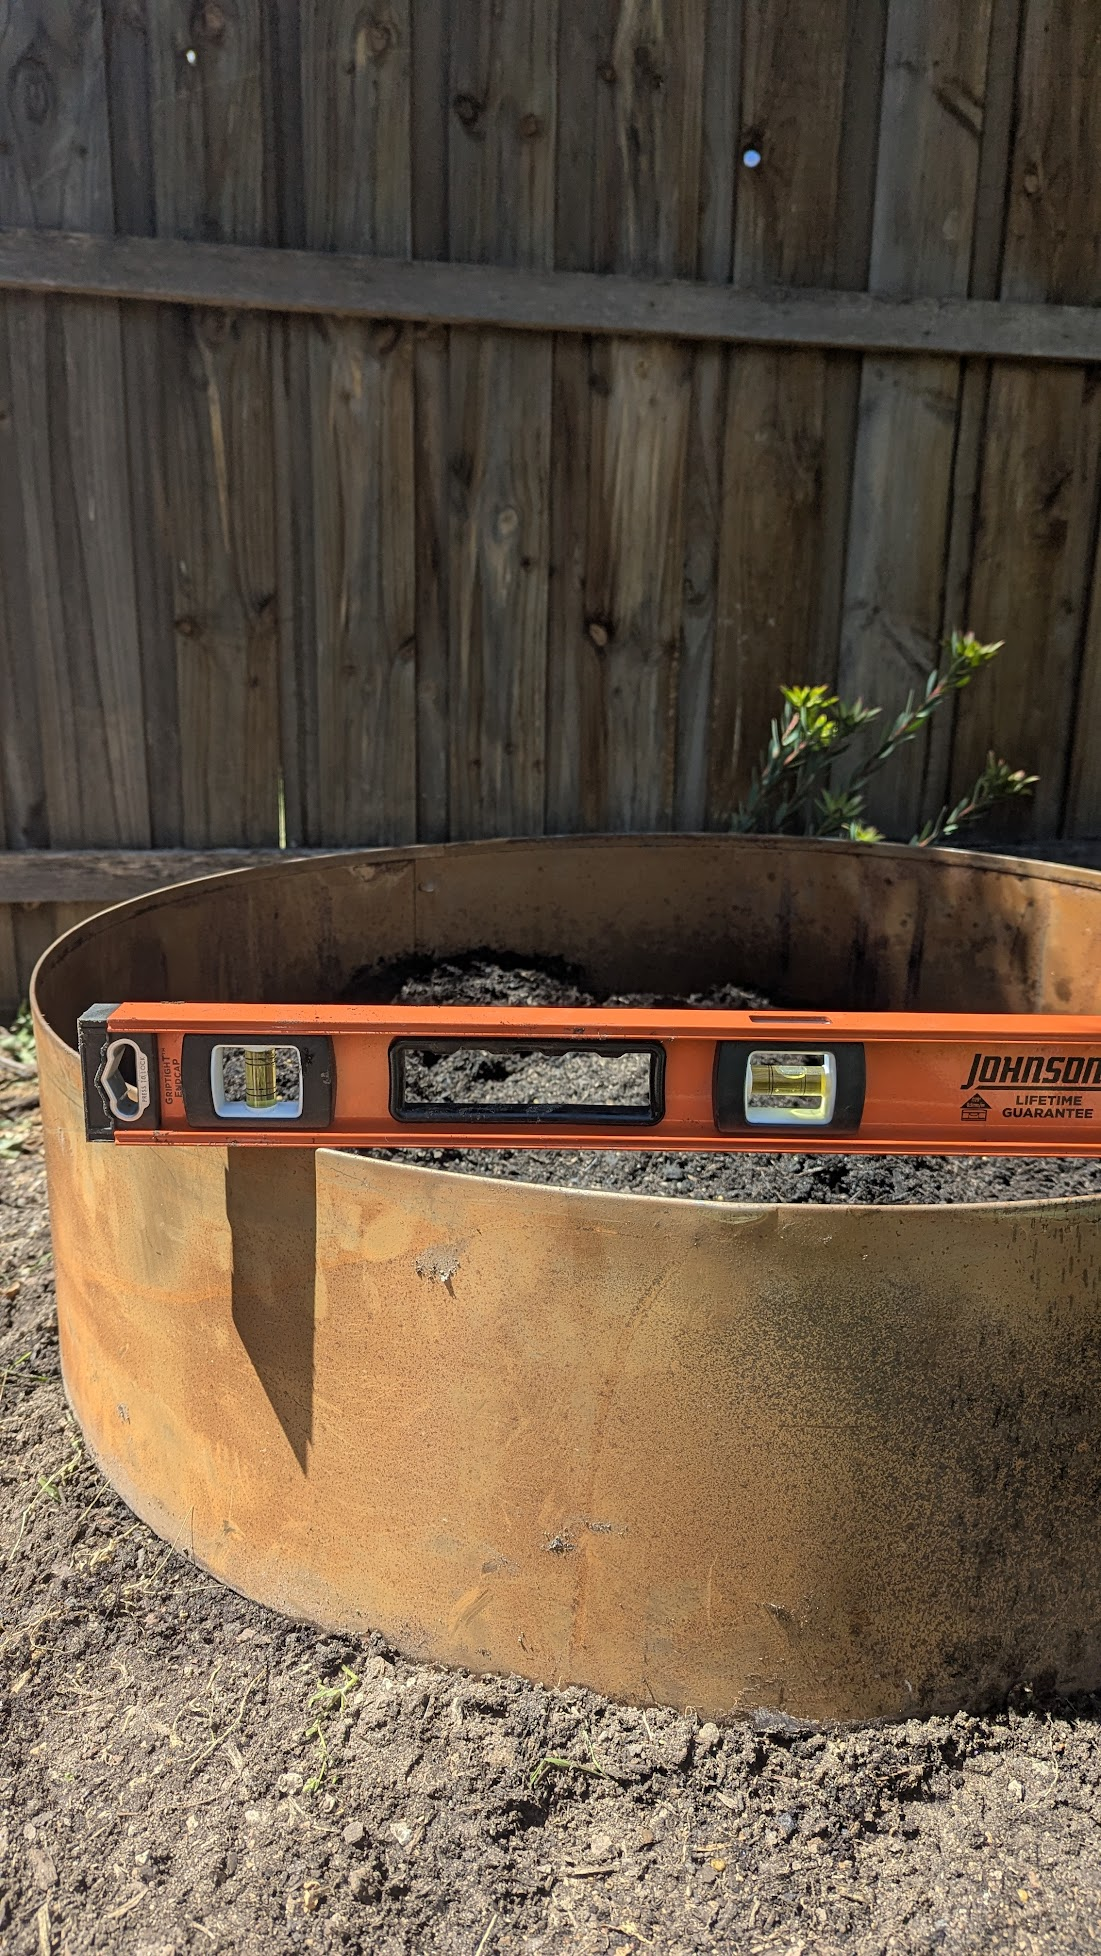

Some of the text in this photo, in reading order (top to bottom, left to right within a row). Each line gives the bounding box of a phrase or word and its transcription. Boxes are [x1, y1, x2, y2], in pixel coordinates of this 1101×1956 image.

[172, 1059, 182, 1097] ENDCAP
[960, 1054, 1101, 1089] JOHNSON
[1016, 1095, 1082, 1106] LIFETIME
[1002, 1108, 1093, 1119] GUARANTEE
